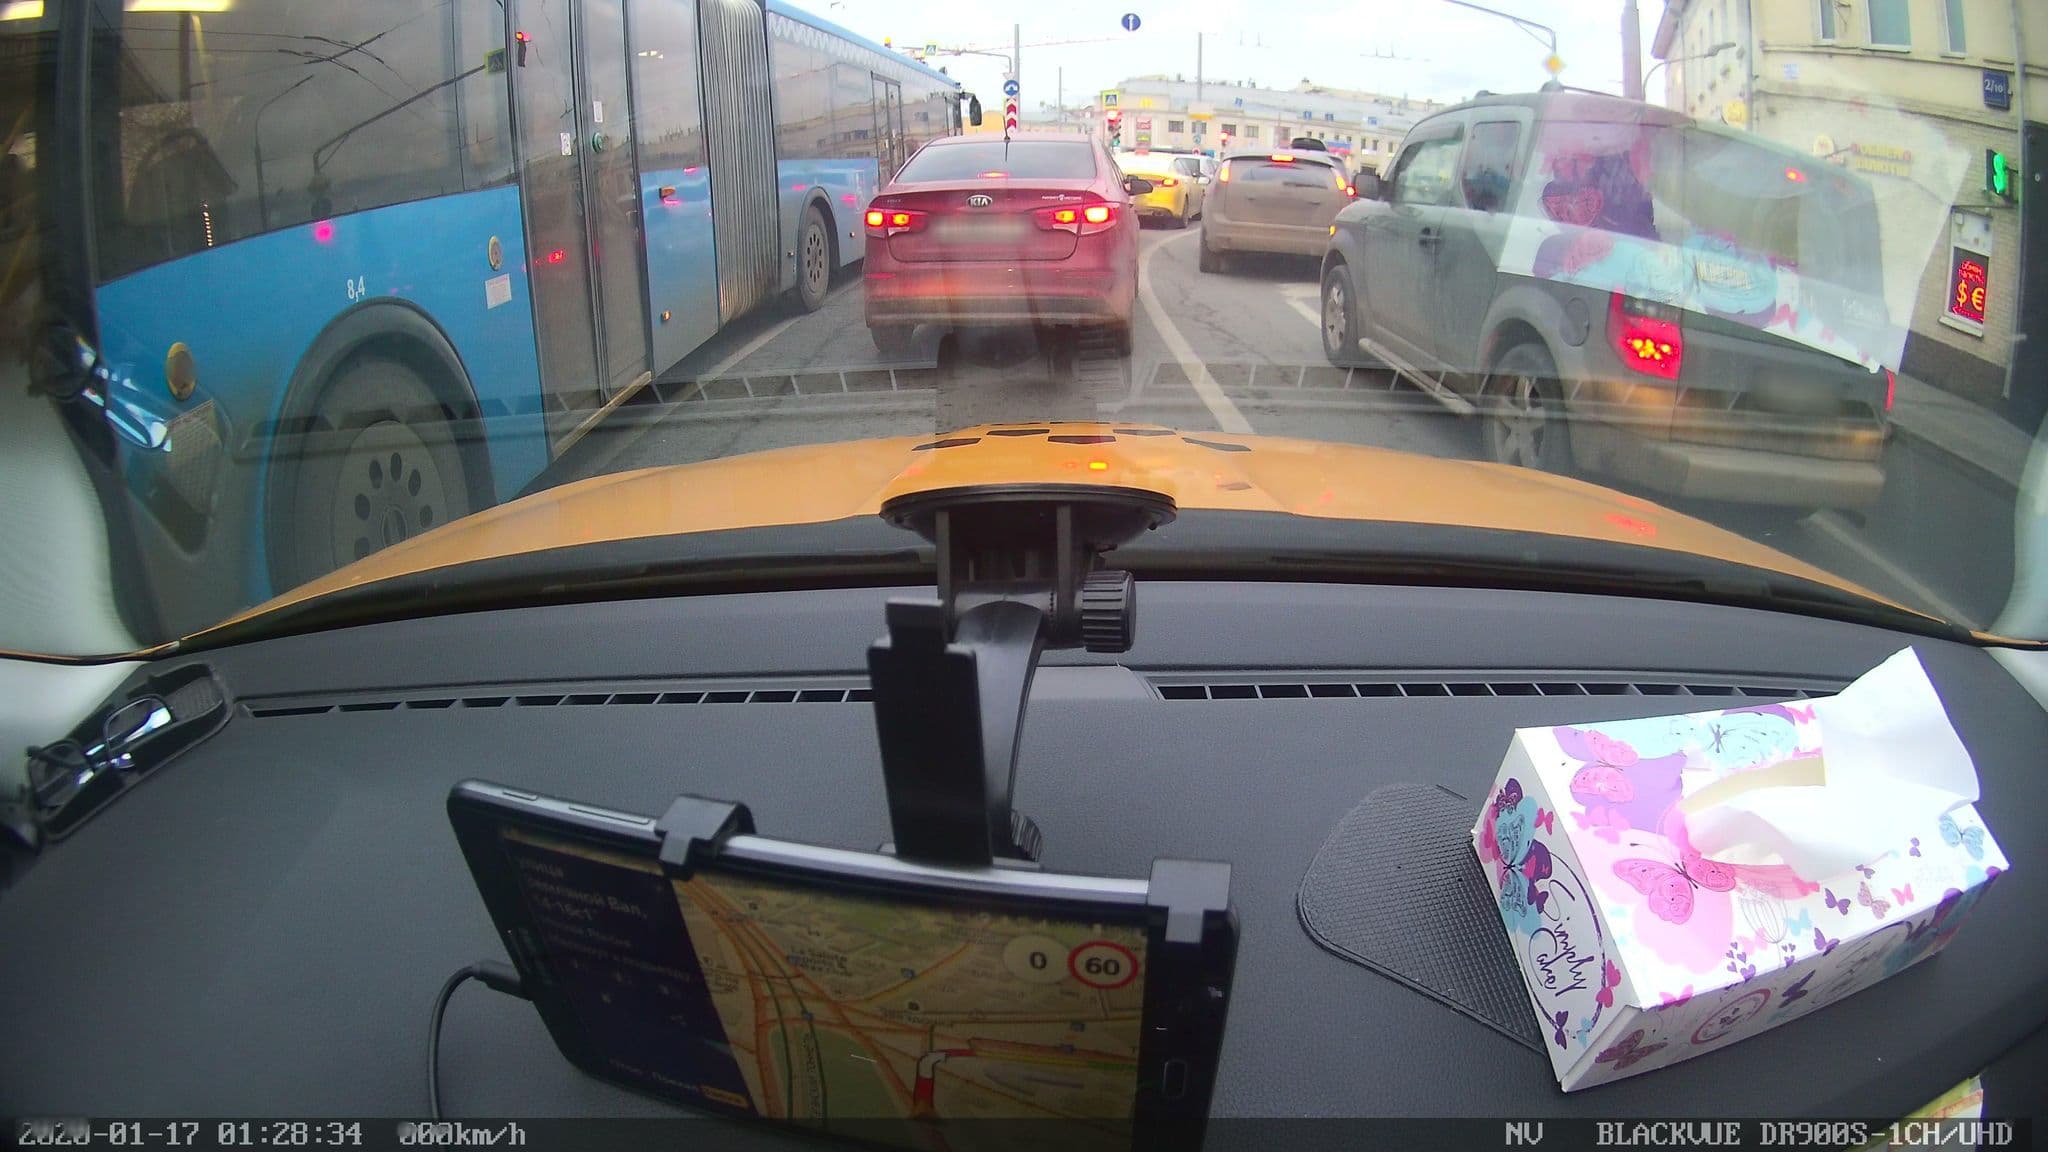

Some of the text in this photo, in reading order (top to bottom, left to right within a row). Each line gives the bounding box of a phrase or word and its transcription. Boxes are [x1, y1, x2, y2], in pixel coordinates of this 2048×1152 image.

[1984, 79, 2004, 94] 2/10
[347, 275, 365, 302] 8,4
[1542, 879, 1595, 997] Simply
[1030, 951, 1048, 971] 0
[1085, 957, 1121, 977] 60
[1528, 927, 1557, 990] Care
